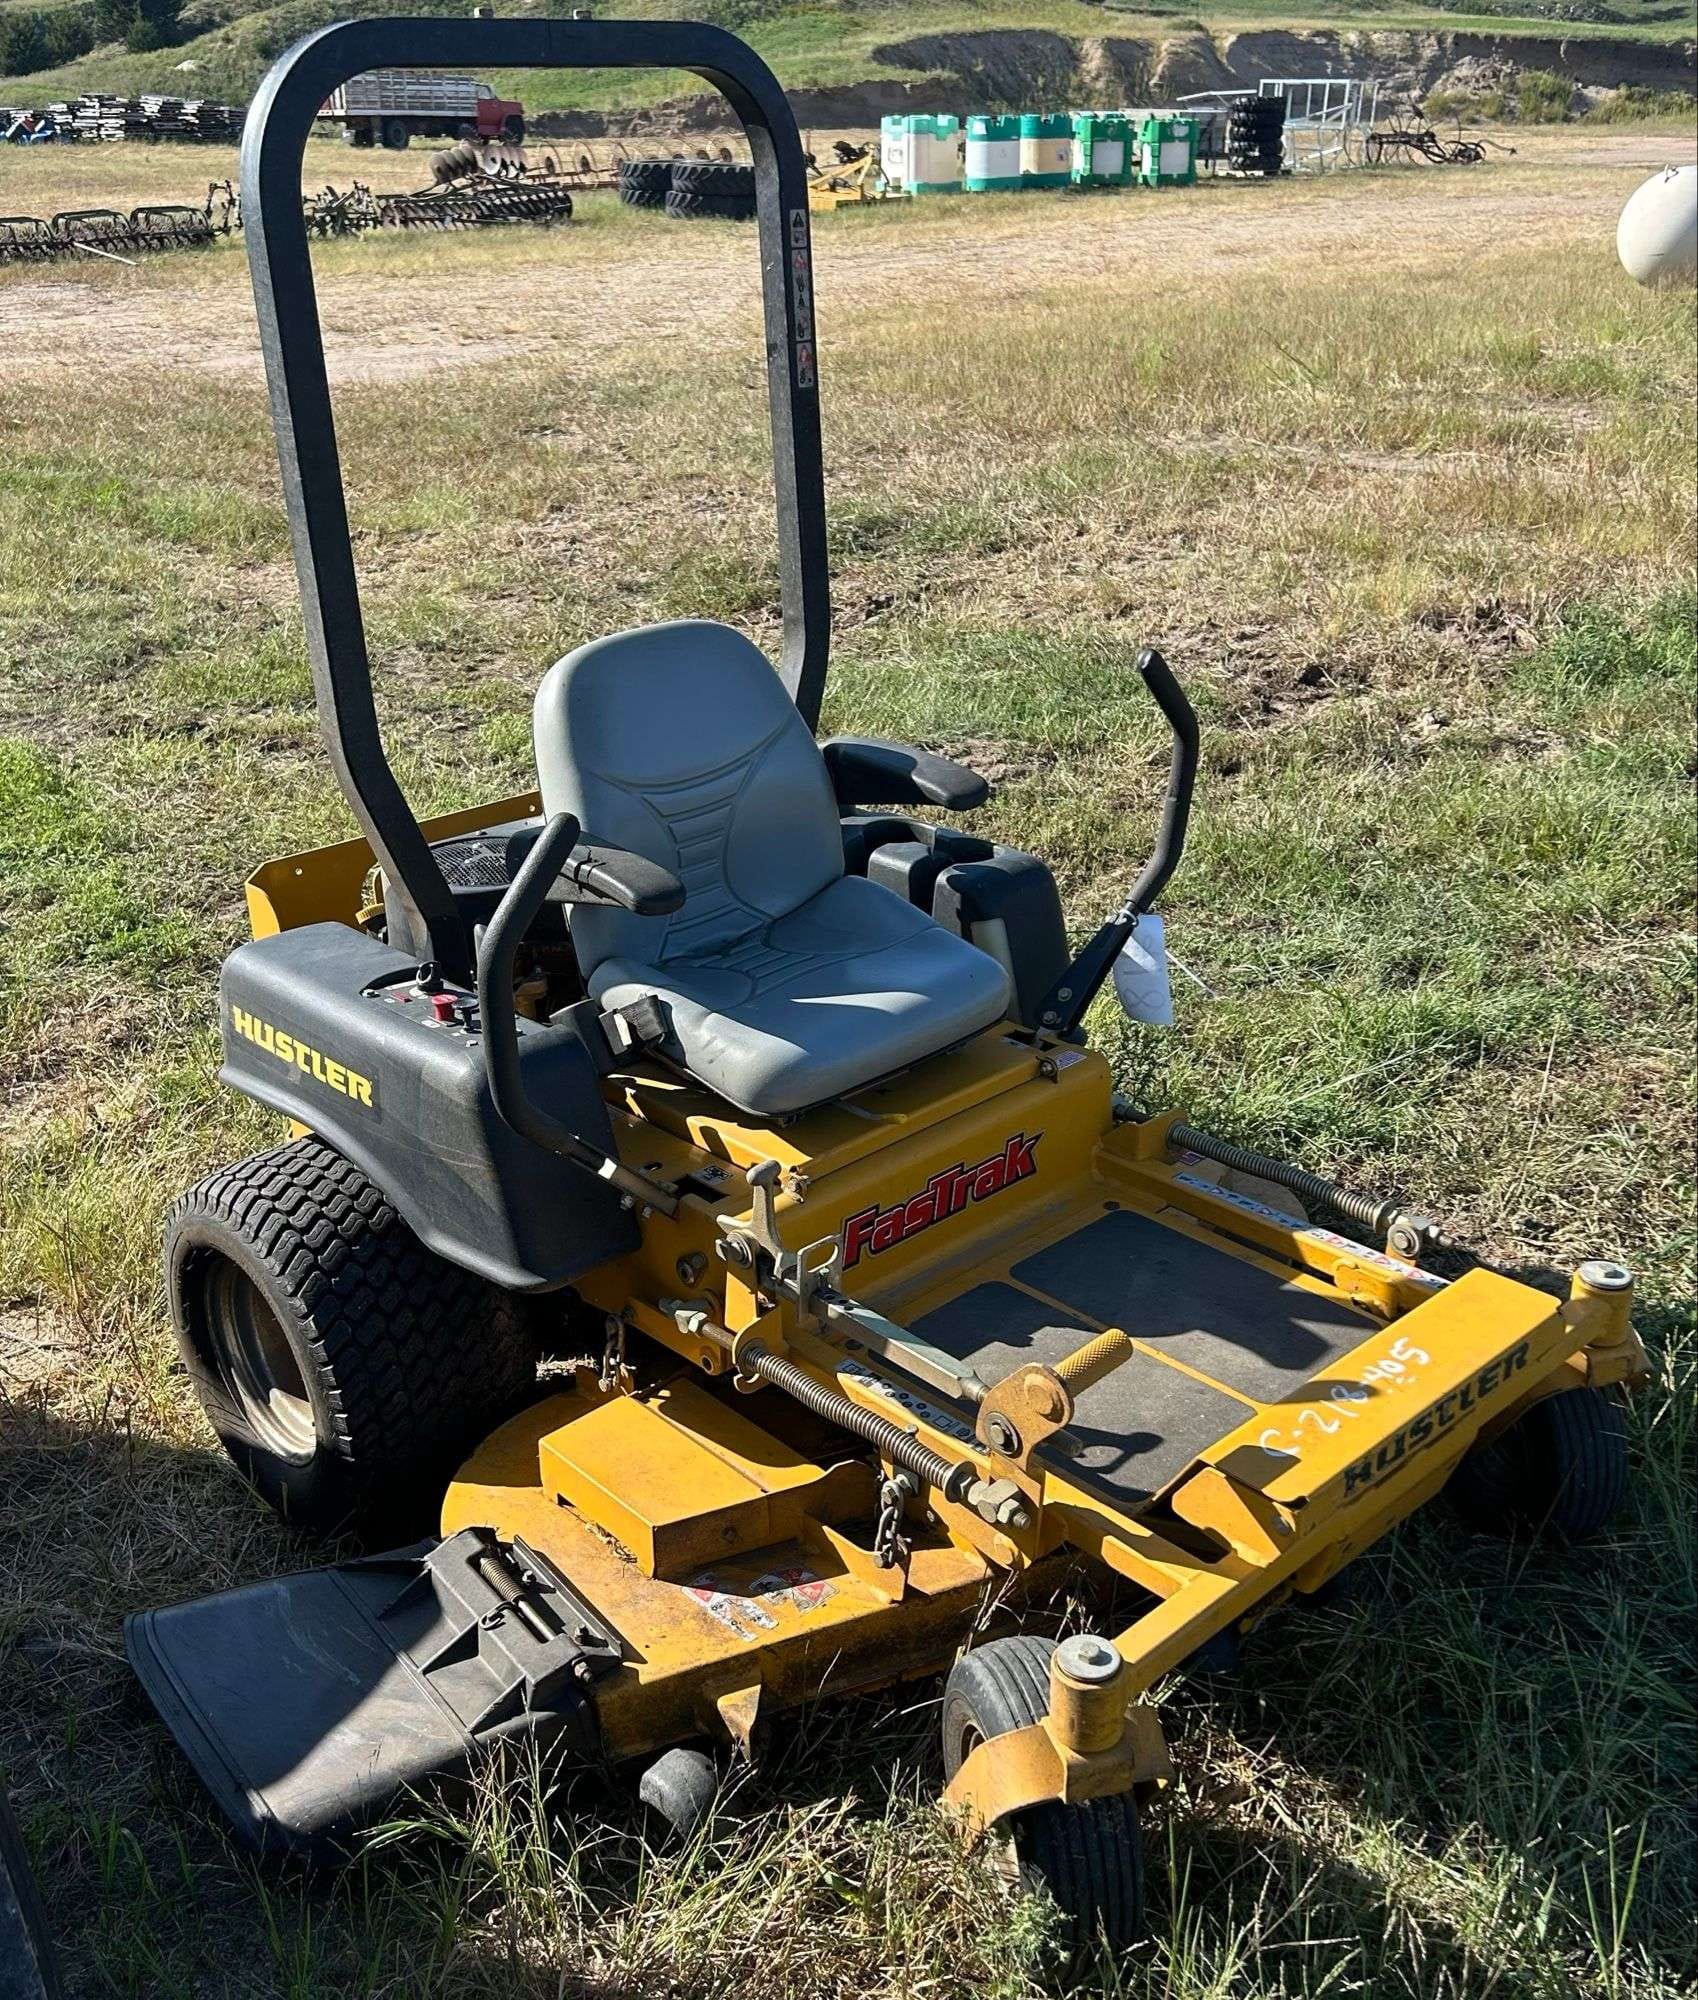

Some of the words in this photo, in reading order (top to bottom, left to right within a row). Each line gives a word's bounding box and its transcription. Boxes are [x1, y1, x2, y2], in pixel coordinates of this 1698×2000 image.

[232, 1004, 373, 1108] HUSTLER
[842, 1130, 1046, 1271] FasTrak
[1343, 1341, 1531, 1498] HUSTLER
